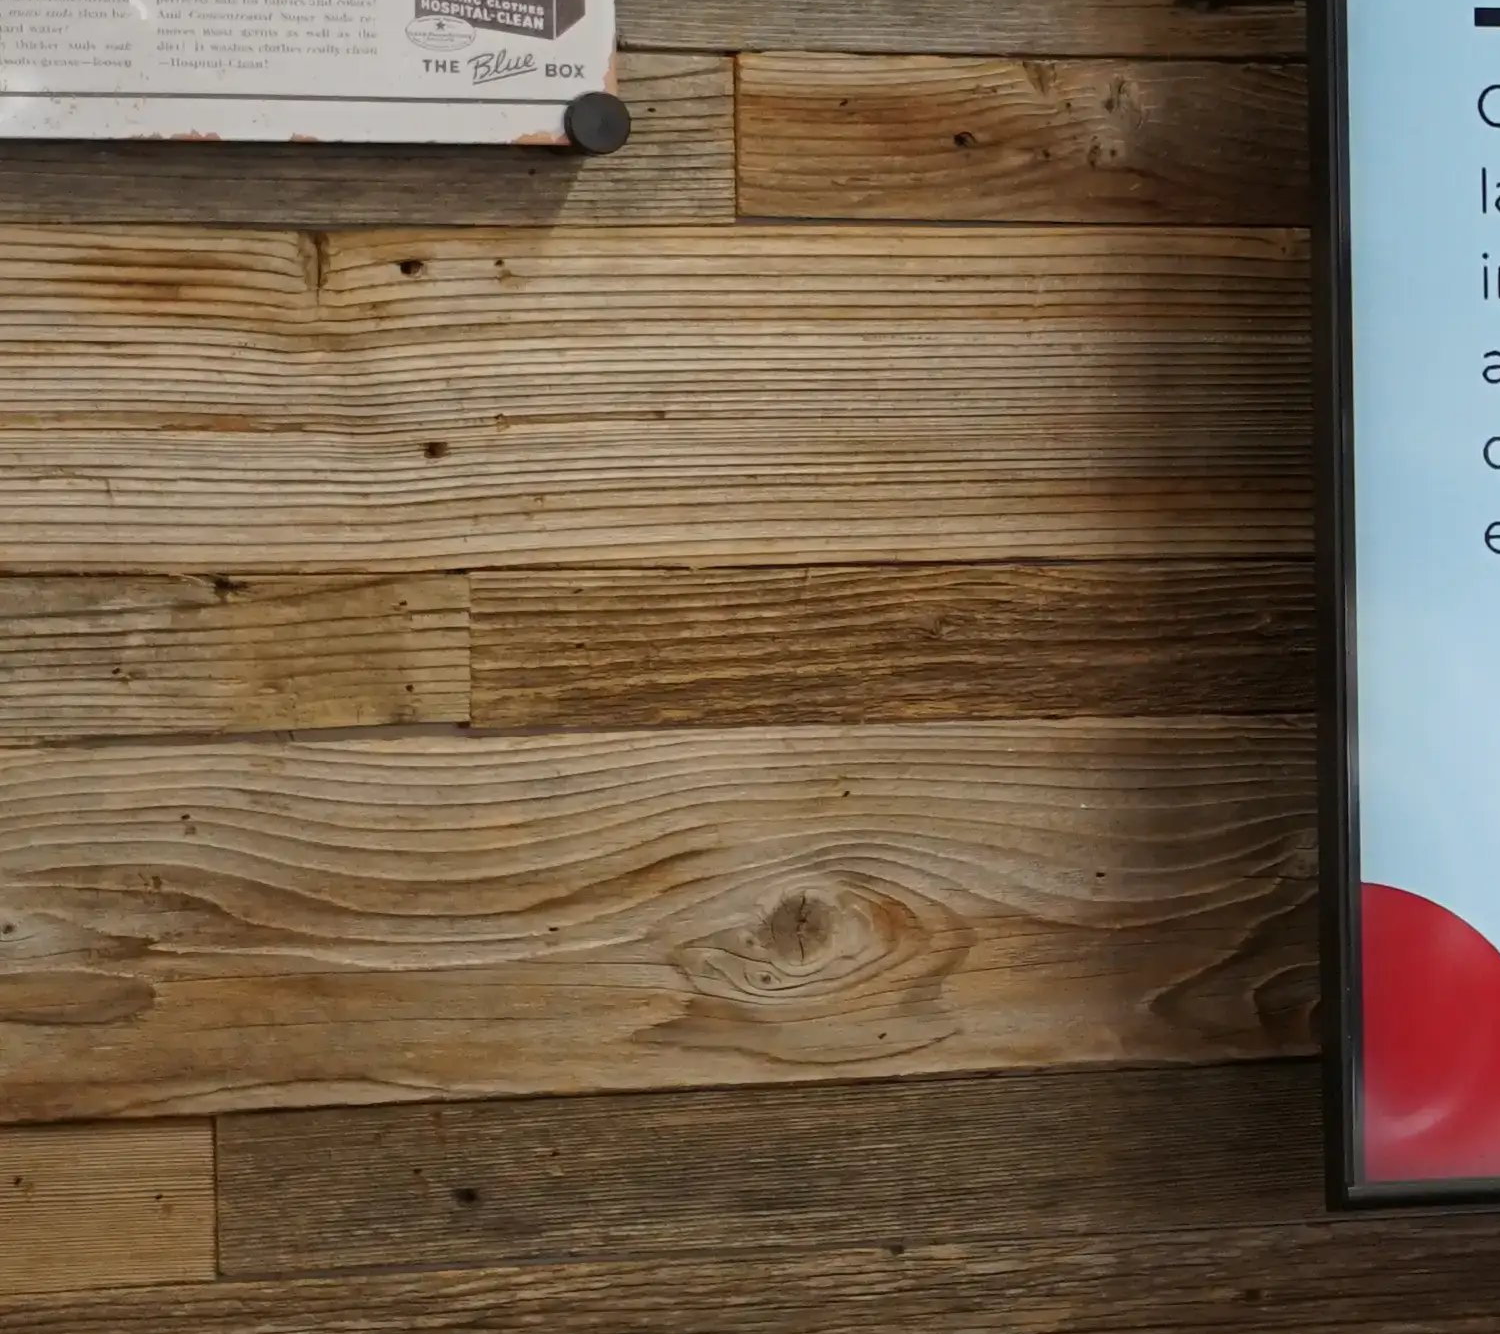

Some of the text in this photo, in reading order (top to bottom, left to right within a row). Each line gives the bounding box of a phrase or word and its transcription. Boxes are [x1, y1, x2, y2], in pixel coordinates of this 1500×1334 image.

[487, 0, 544, 15] CLOTHES
[423, 50, 584, 80] THE Blue BOX
